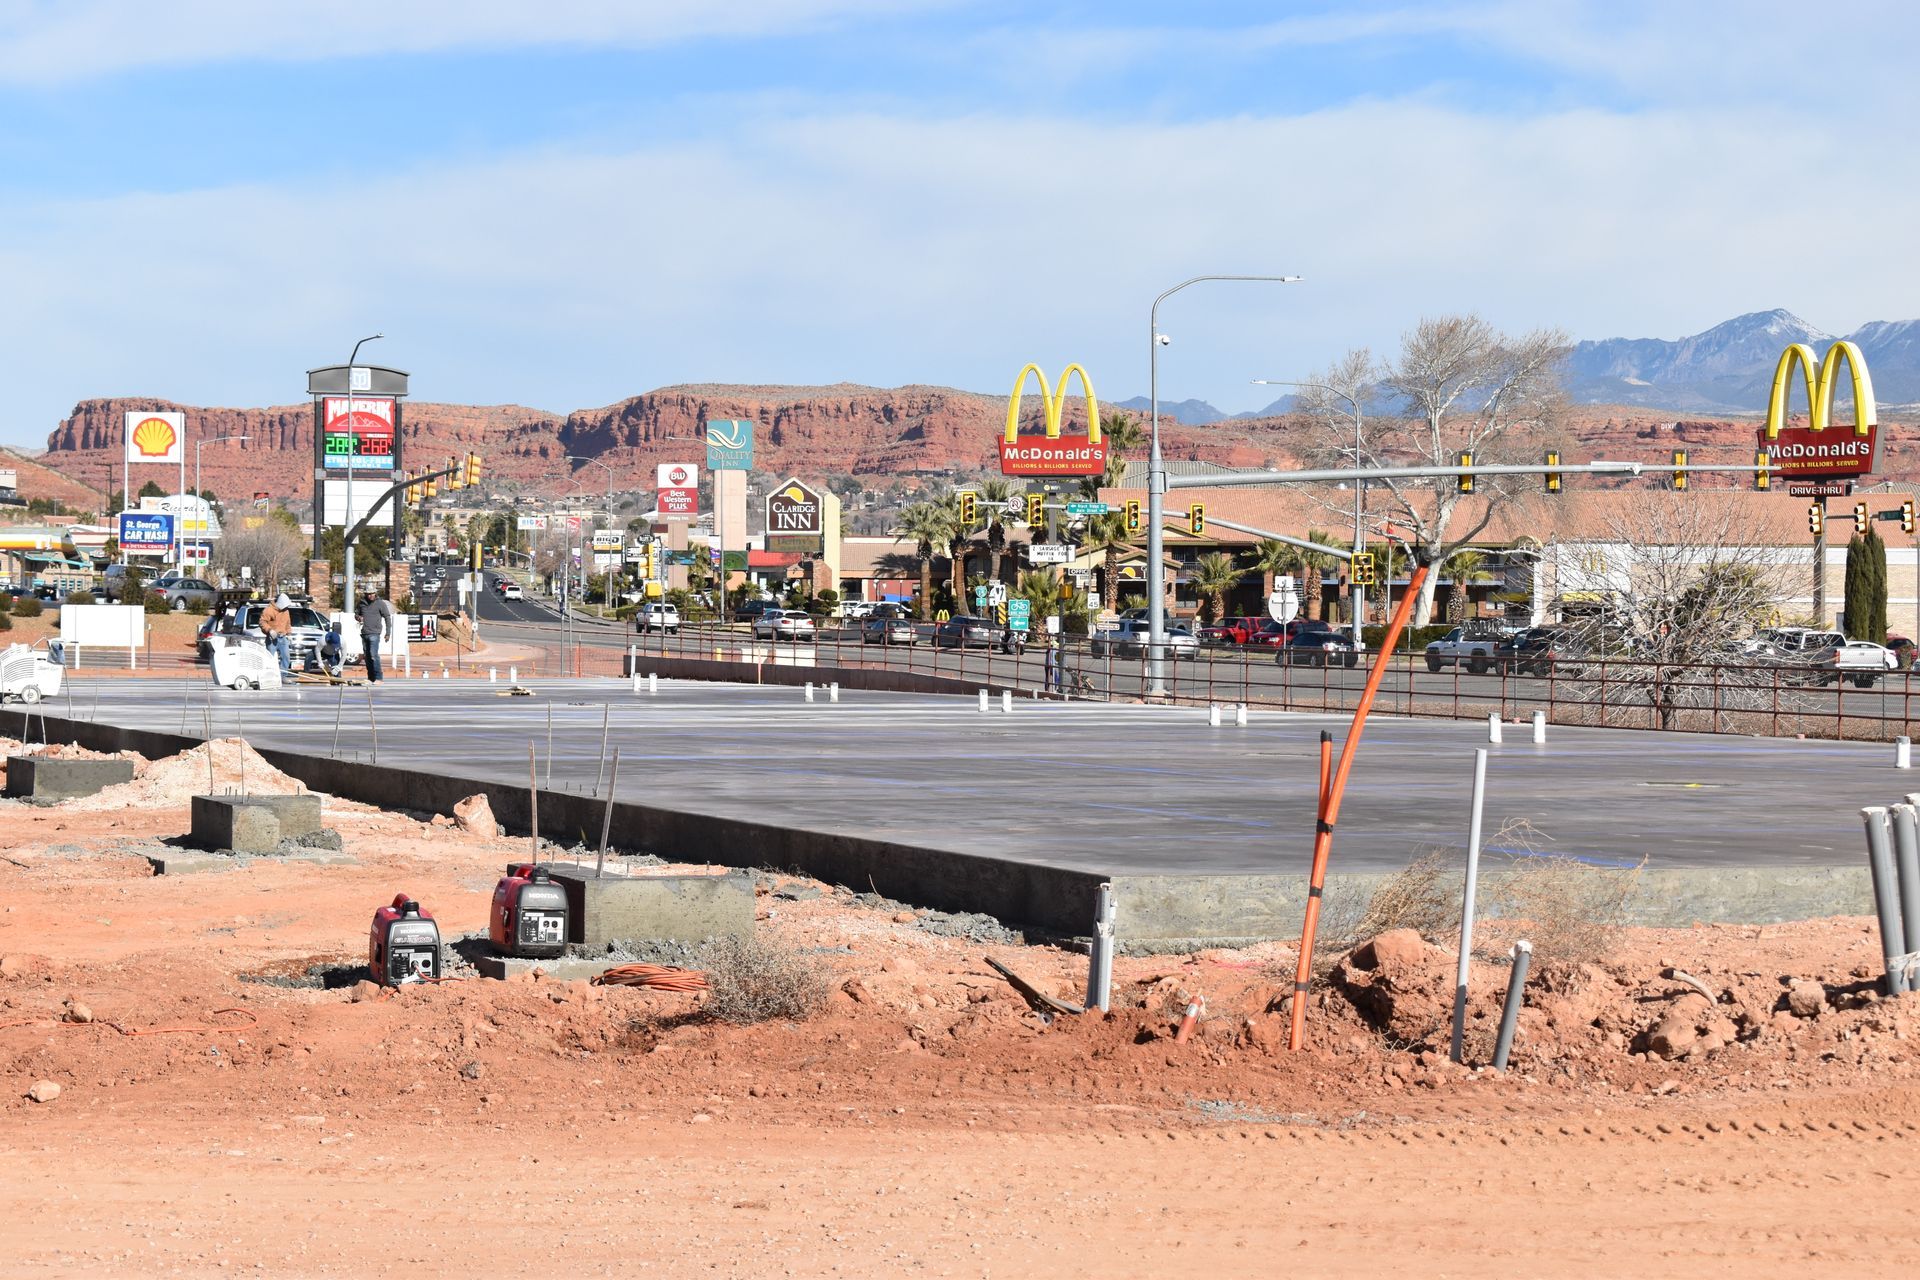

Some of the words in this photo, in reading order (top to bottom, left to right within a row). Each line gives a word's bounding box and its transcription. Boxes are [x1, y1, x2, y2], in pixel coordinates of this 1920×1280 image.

[327, 400, 392, 425] MAVERIK
[1004, 448, 1102, 460] McDonald's
[1767, 441, 1869, 458] McDonald's
[670, 472, 686, 480] BW
[1791, 486, 1842, 495] DRIVE-THRU
[772, 502, 816, 513] CLARIDGE
[136, 521, 160, 530] George
[777, 513, 811, 528] INN
[124, 531, 143, 540] CAR
[144, 531, 168, 540] WASH
